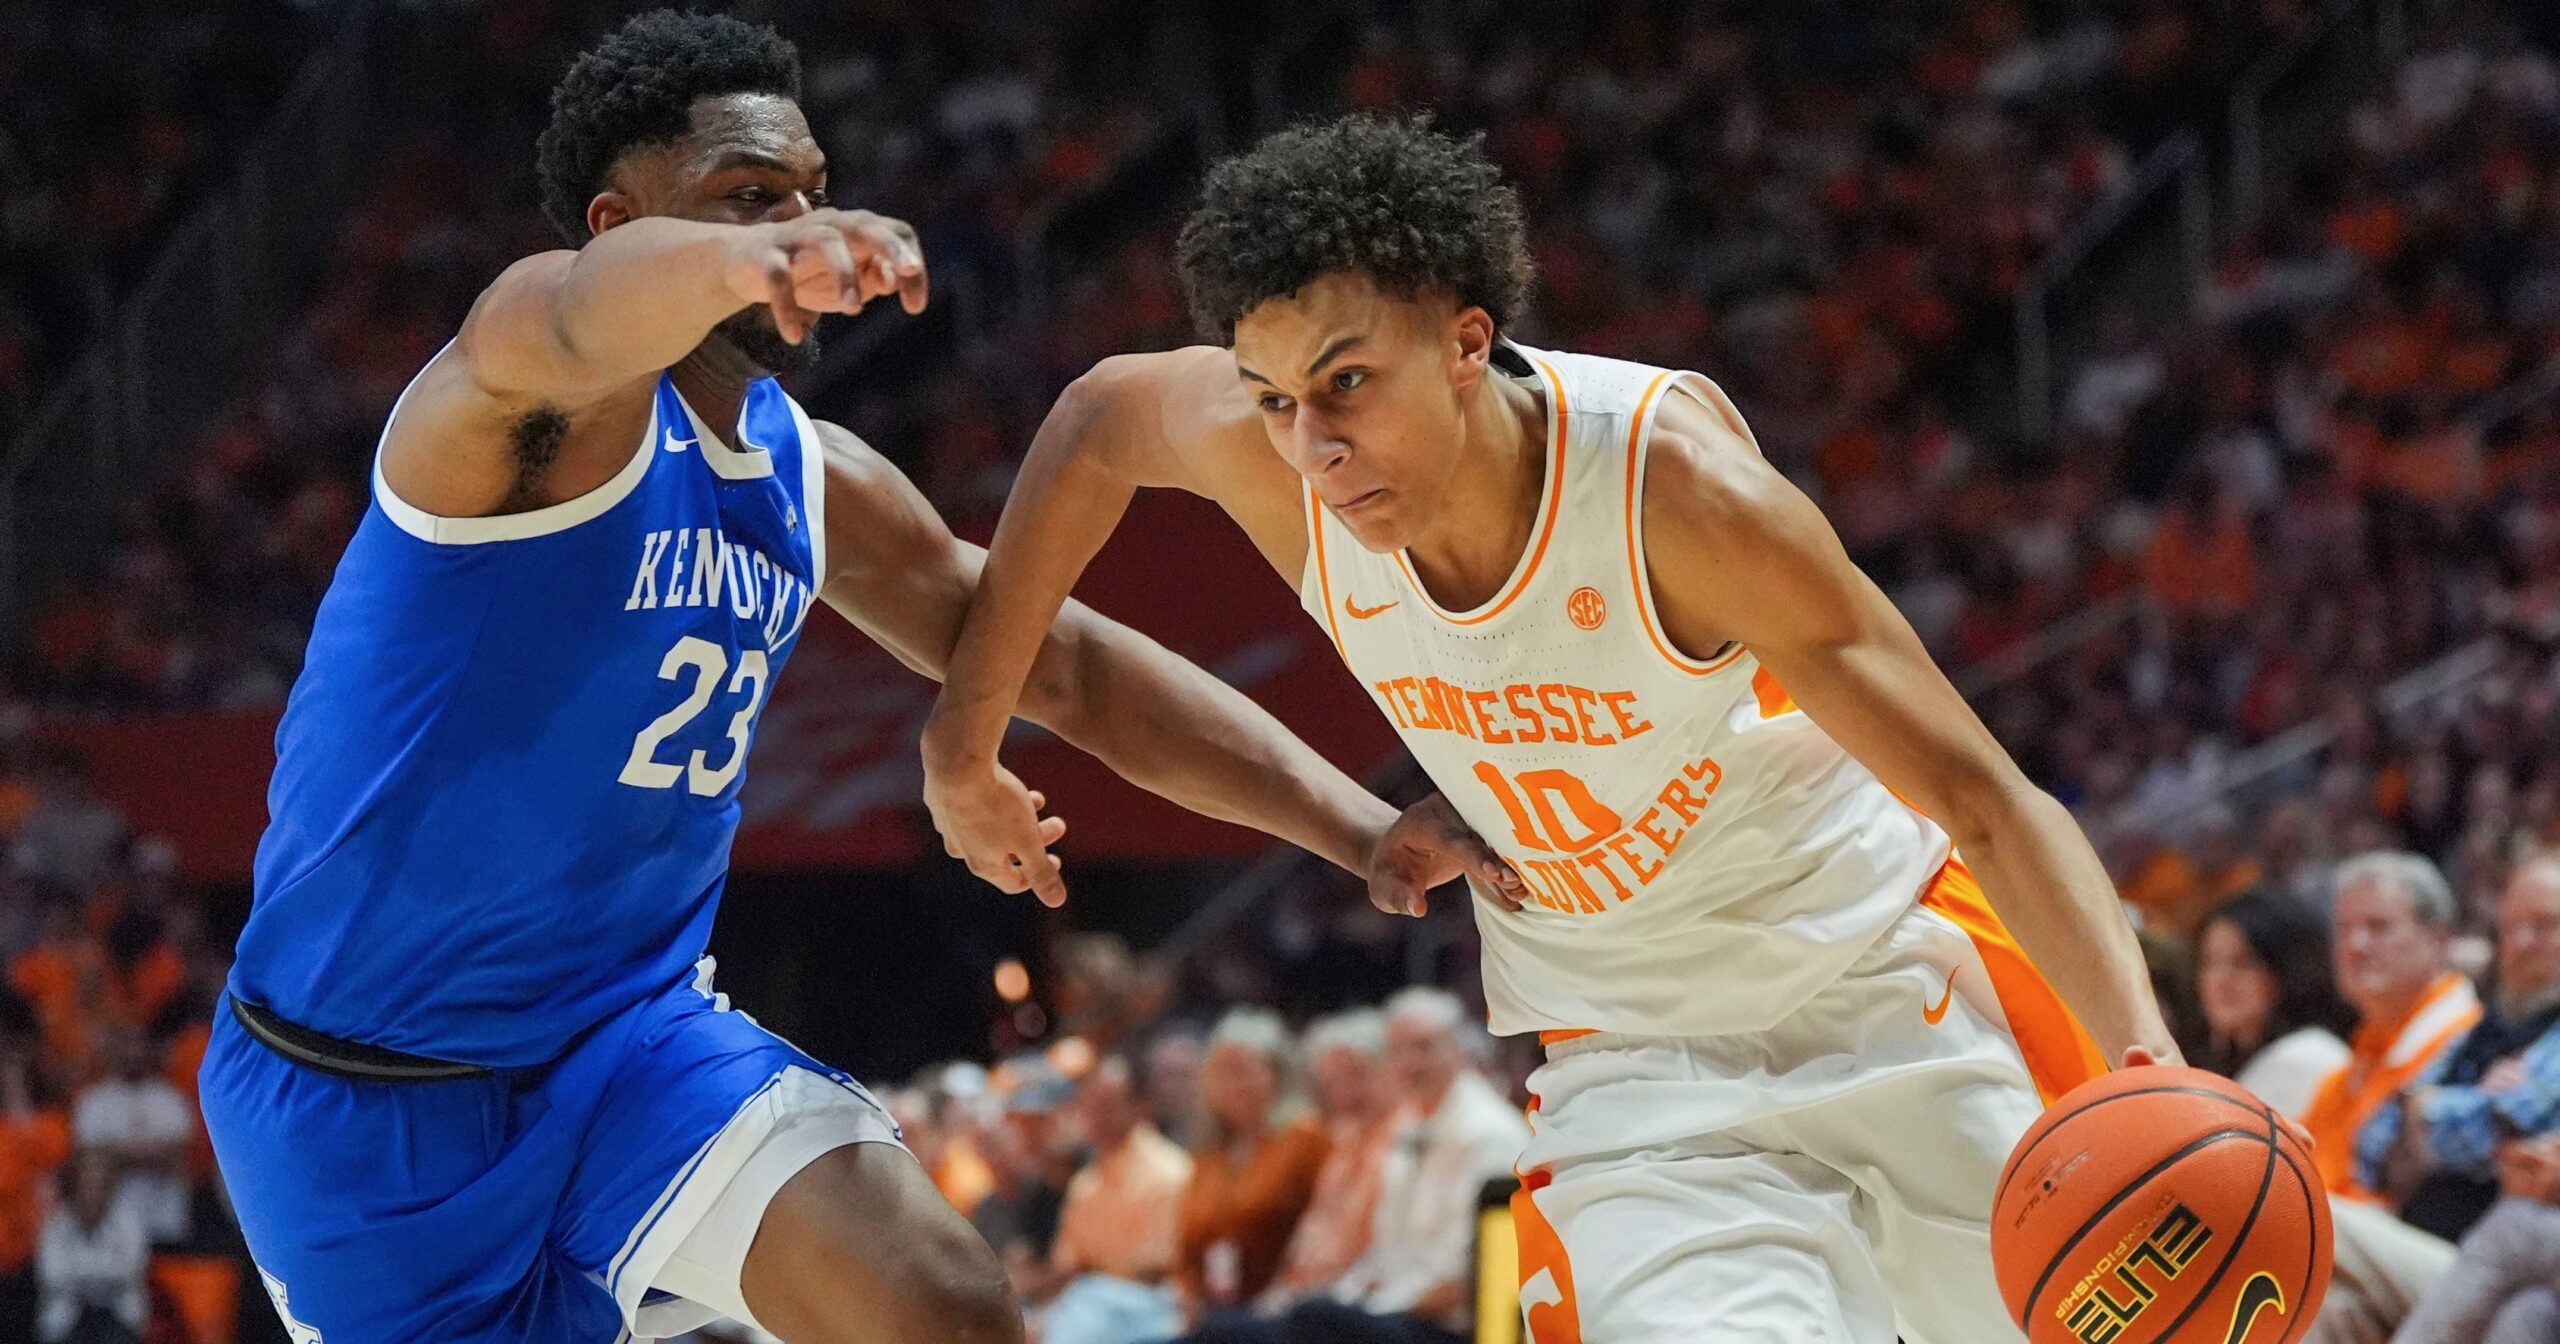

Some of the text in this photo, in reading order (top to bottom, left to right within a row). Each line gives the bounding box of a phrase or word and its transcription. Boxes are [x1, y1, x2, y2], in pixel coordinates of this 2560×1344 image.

[624, 527, 812, 654] KENUCKY
[1570, 590, 1603, 627] SEC
[617, 635, 769, 797] 23
[1375, 676, 1655, 746] TENNESSEE
[1471, 759, 1622, 854] 10
[1503, 756, 1722, 914] LUNTEERS
[2063, 1202, 2214, 1344] ELITE
